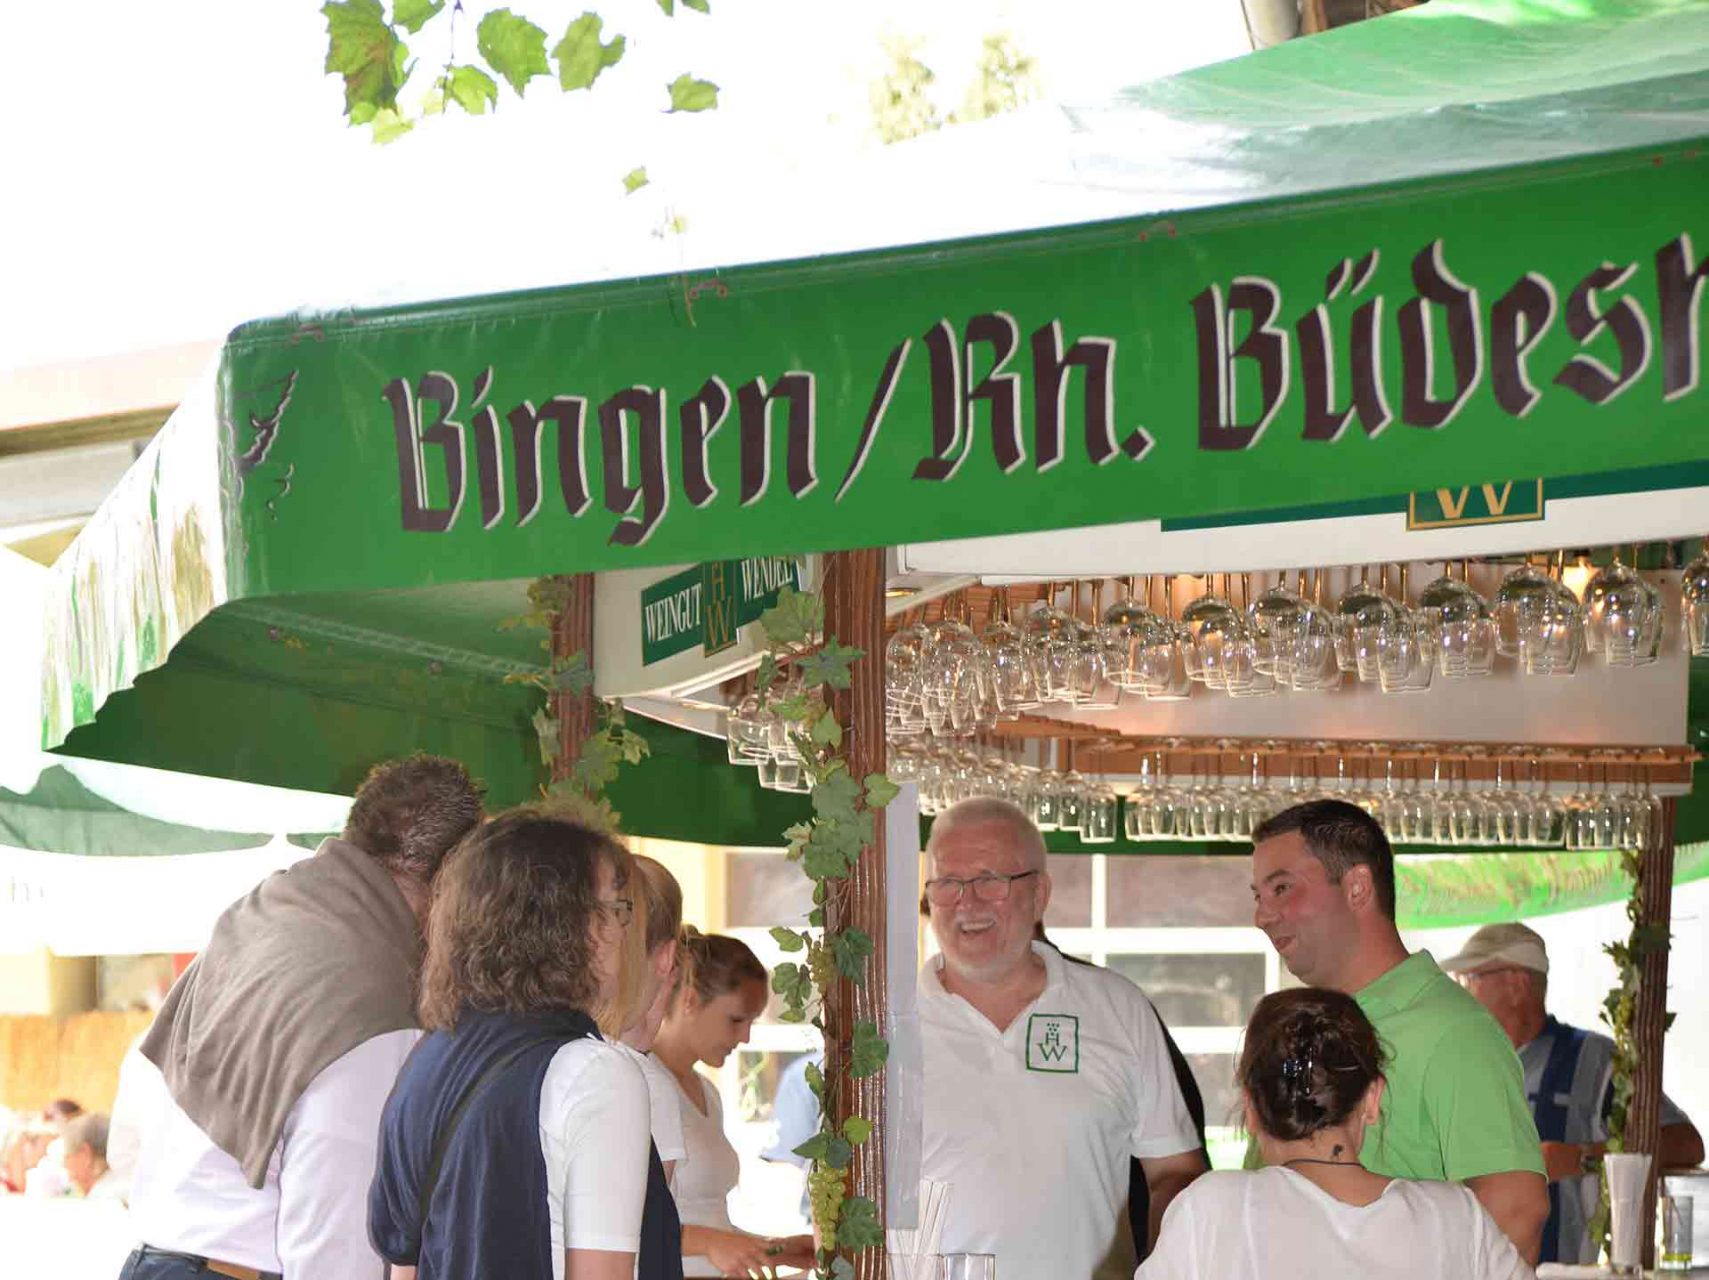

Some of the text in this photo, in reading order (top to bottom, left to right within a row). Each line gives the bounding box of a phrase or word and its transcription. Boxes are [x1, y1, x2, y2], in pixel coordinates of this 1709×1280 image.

[381, 364, 819, 547] Bingen
[645, 556, 793, 642] WEINGUT WENDEL
